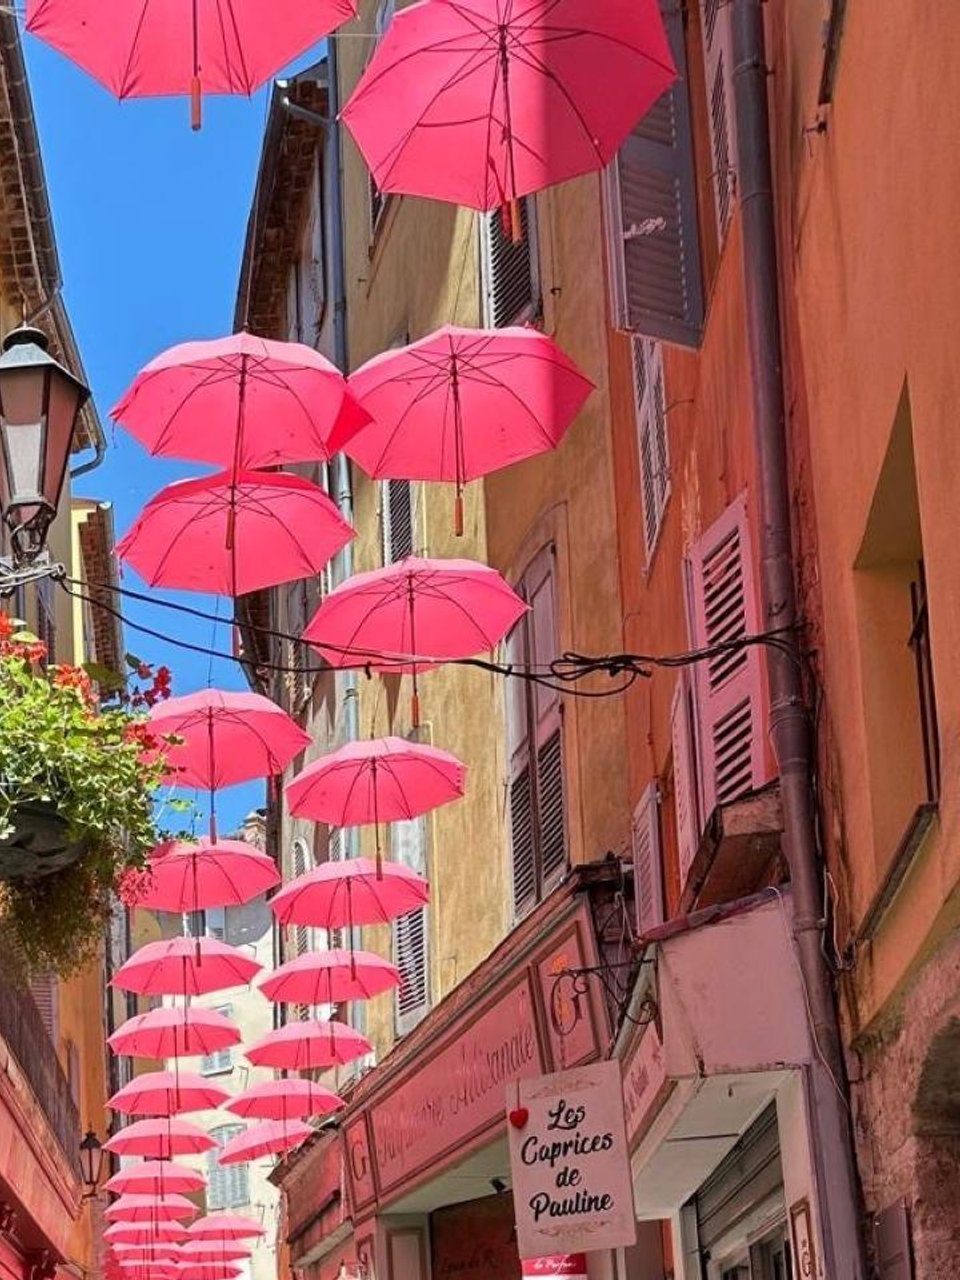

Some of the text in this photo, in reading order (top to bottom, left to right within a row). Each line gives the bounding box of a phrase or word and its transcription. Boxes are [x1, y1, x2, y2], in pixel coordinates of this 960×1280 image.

[548, 1099, 586, 1130] Les
[521, 1132, 614, 1168] Caprices
[556, 1166, 582, 1188] de
[529, 1189, 615, 1222] Pauline
